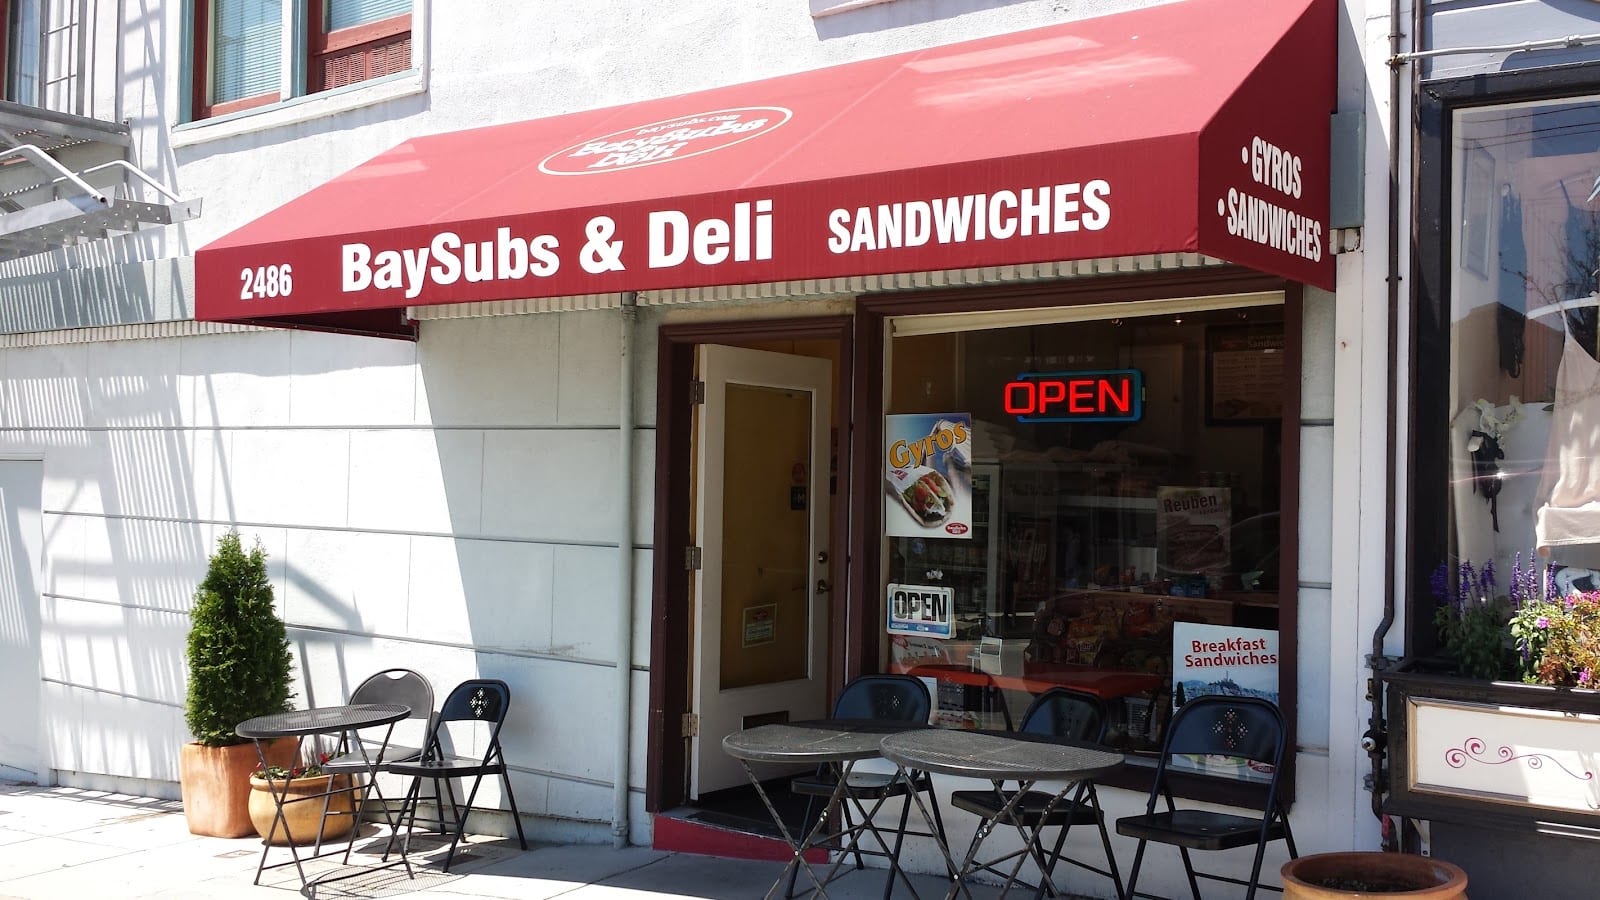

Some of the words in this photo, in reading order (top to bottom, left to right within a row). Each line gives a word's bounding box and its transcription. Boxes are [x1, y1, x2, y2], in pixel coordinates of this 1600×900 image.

[587, 141, 689, 168] Deli
[1251, 136, 1302, 199] GYROS
[240, 264, 293, 300] 2486
[342, 227, 559, 298] BaySubs
[579, 216, 625, 274] &
[648, 199, 773, 269] Deli
[827, 180, 1111, 254] SANDWICHES
[1227, 187, 1321, 262] SANDWICHES
[1004, 379, 1129, 414] OPEN
[889, 421, 967, 469] Gyros
[1163, 495, 1217, 513] Reuben
[894, 591, 947, 623] OPEN
[1185, 652, 1277, 667] Sandwiches
[1191, 638, 1266, 653] Breakfast
